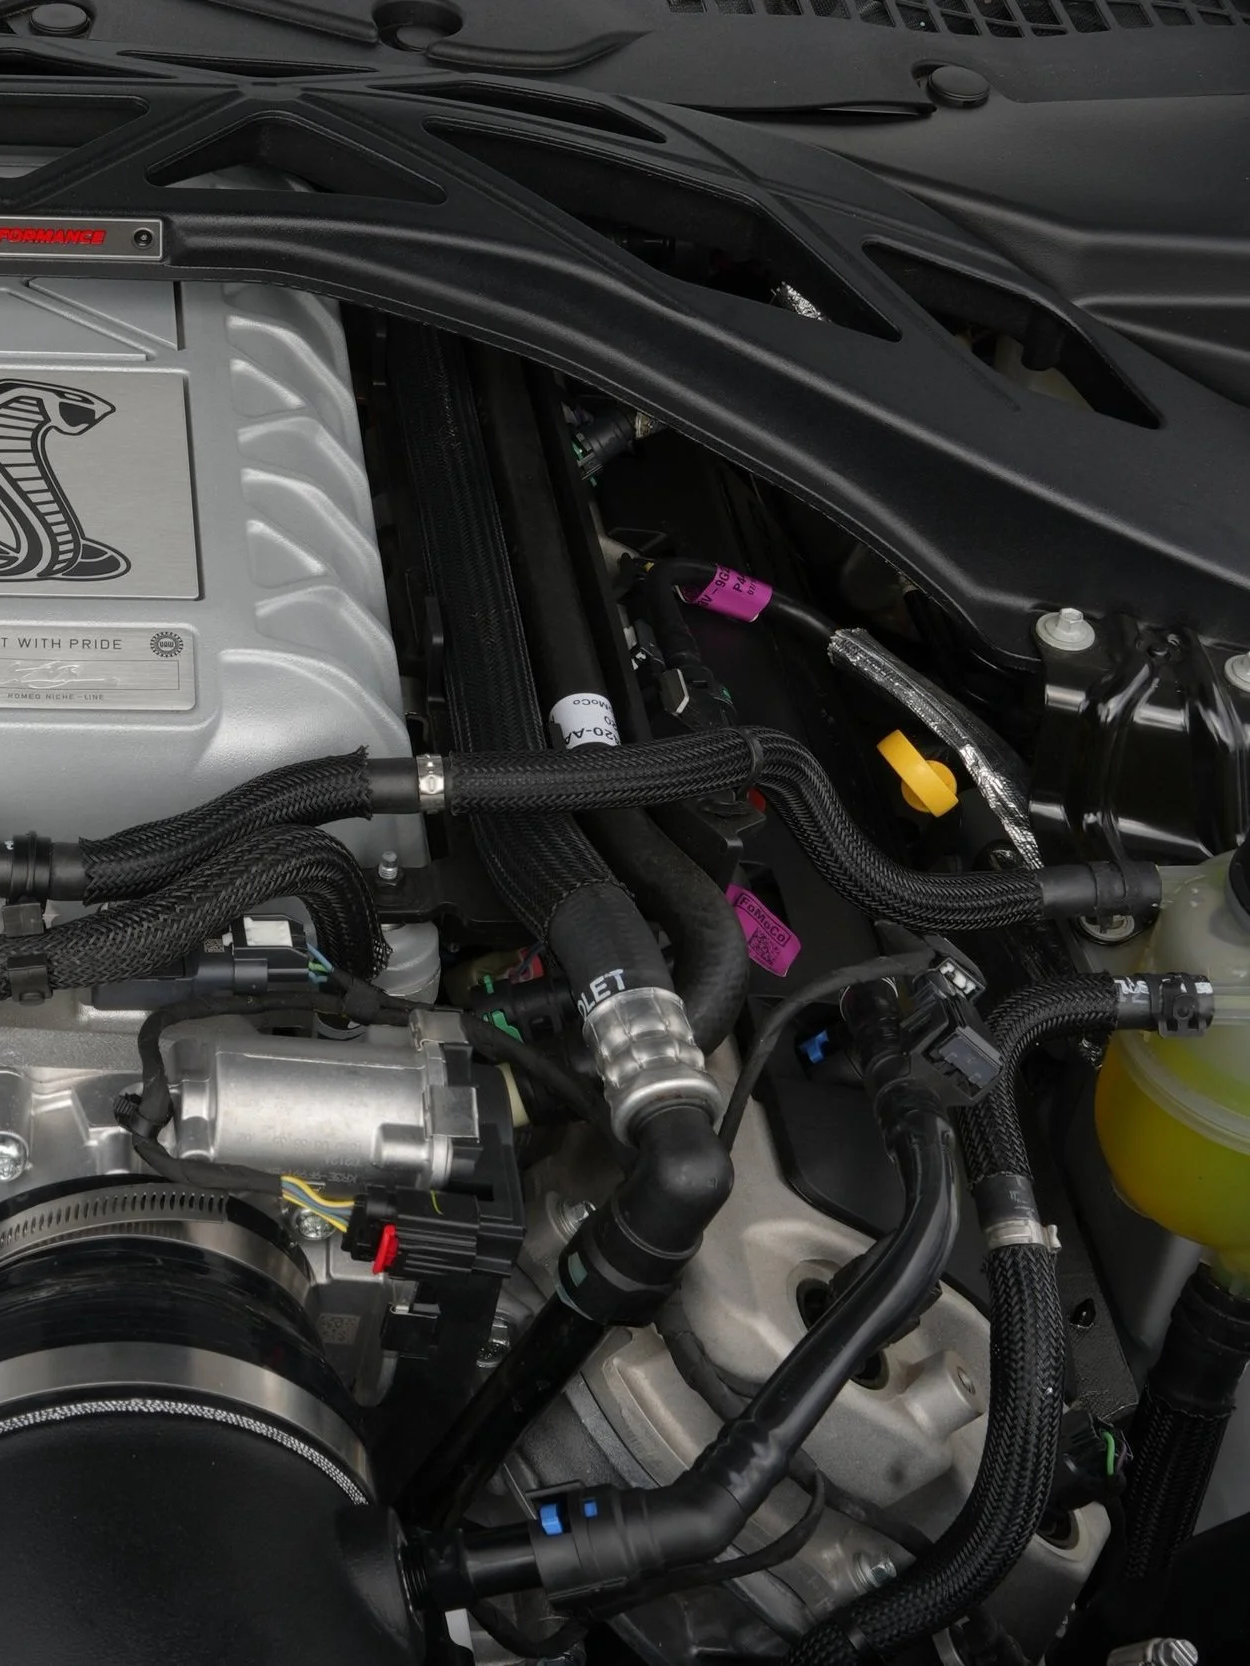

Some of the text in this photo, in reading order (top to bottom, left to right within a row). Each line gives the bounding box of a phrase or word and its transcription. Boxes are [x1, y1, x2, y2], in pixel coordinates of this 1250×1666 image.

[17, 637, 62, 649] WITH
[69, 638, 123, 650] PRIDE
[7, 692, 41, 700] ROMEO
[739, 896, 786, 943] FoMoCo
